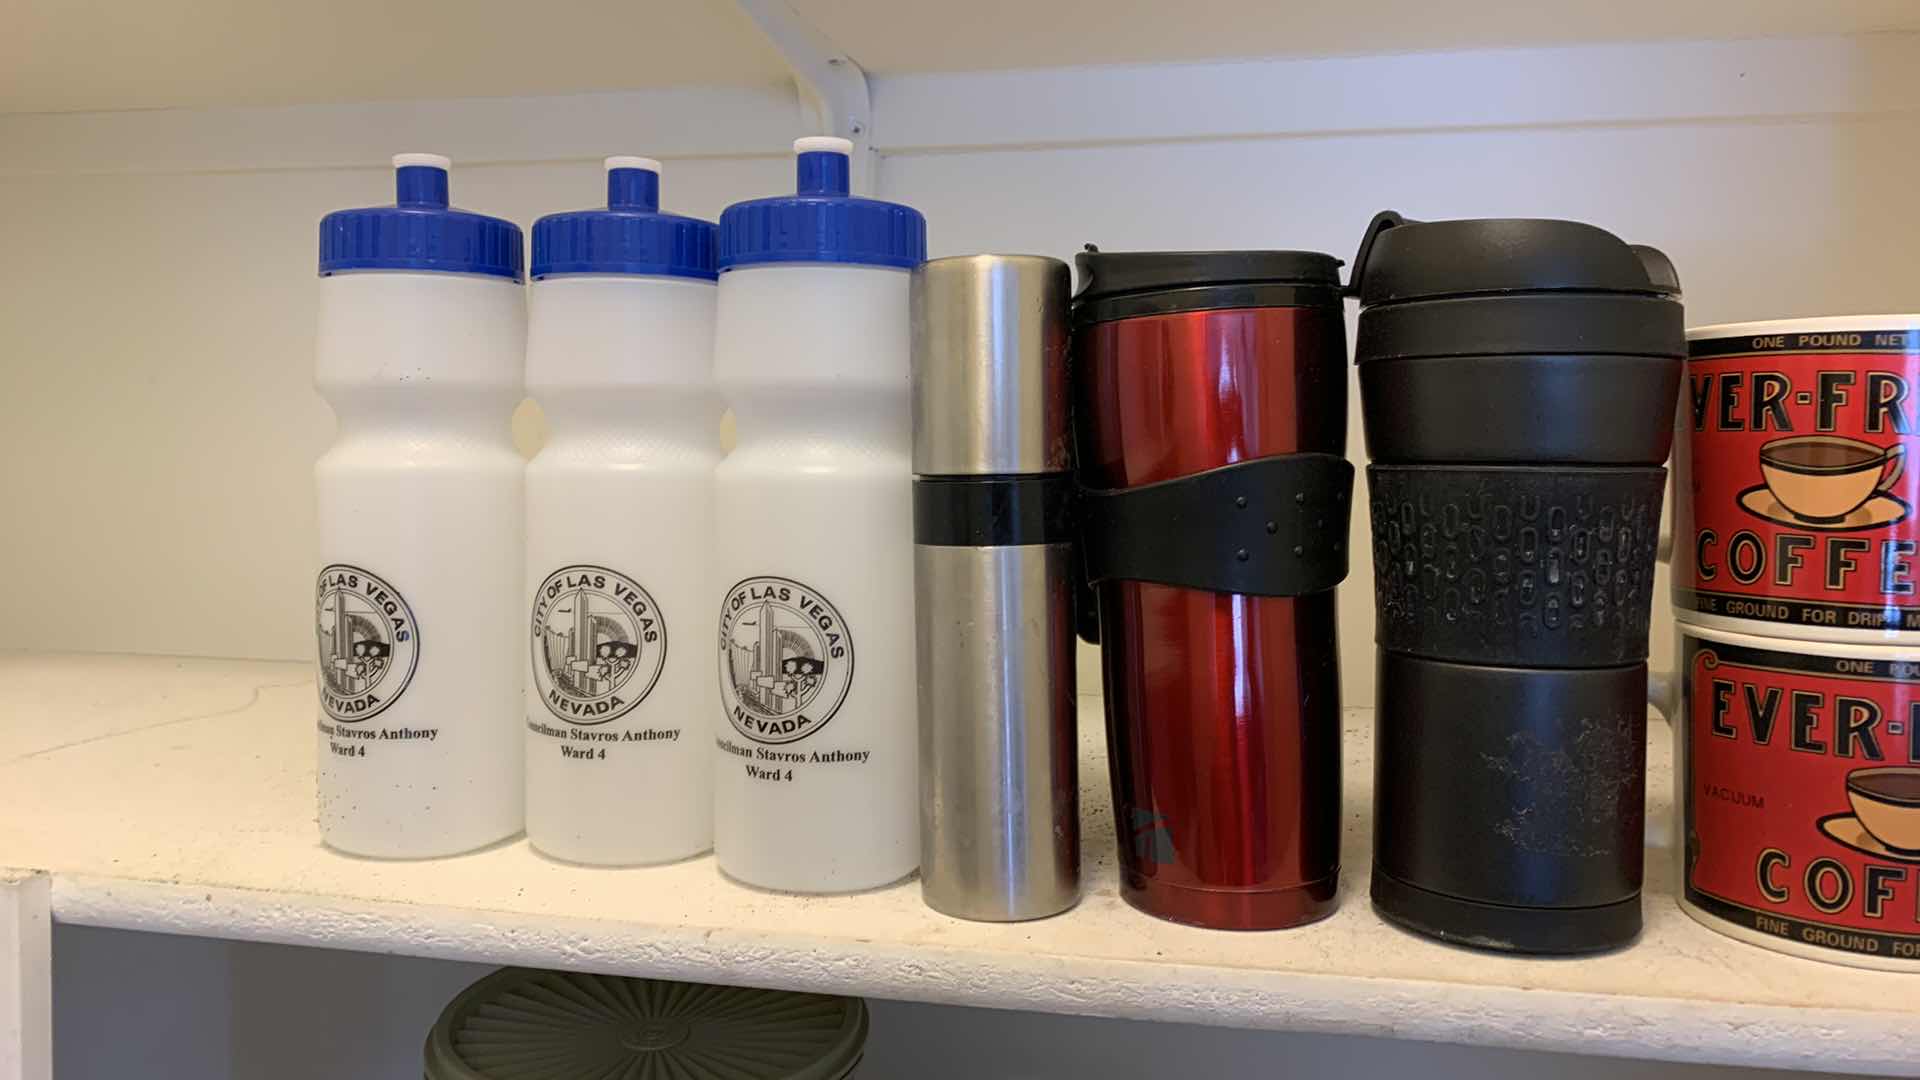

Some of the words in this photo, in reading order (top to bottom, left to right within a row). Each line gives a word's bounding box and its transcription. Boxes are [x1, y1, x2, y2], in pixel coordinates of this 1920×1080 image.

[1752, 335, 1785, 350] ONE
[1798, 333, 1862, 348] POUND
[1874, 333, 1907, 347] NET
[1688, 370, 1920, 434] VER-FR
[1696, 528, 1917, 596] COFFE
[328, 573, 359, 589] LAS
[365, 581, 410, 643] VEGAS
[534, 599, 549, 638] CITY
[546, 579, 564, 600] OF
[566, 574, 606, 589] LAS
[613, 583, 658, 643] VEGAS
[1726, 600, 1790, 620] GROUND
[1802, 607, 1838, 625] FOR
[720, 608, 733, 650] CITY
[731, 591, 747, 611] OF
[750, 585, 792, 602] LAS
[799, 595, 845, 660] VEGAS
[1836, 660, 1873, 674] ONE
[548, 688, 625, 717] NEVADA
[335, 725, 376, 740] Stavros
[378, 727, 438, 741] Anthony
[733, 705, 812, 735] NEVADA
[570, 727, 619, 742] Stavros
[622, 727, 681, 743] Anthony
[329, 741, 356, 757] Ward
[358, 745, 365, 757] 4
[561, 745, 594, 760] Ward
[598, 748, 606, 760] 4
[756, 746, 806, 763] Stavros
[808, 749, 871, 764] Anthony
[745, 764, 781, 781] Ward
[784, 769, 793, 782] 4
[1702, 783, 1765, 809] VACUUM
[1755, 847, 1920, 922] COF
[1755, 915, 1790, 936] FINE
[1801, 926, 1880, 952] GROUND
